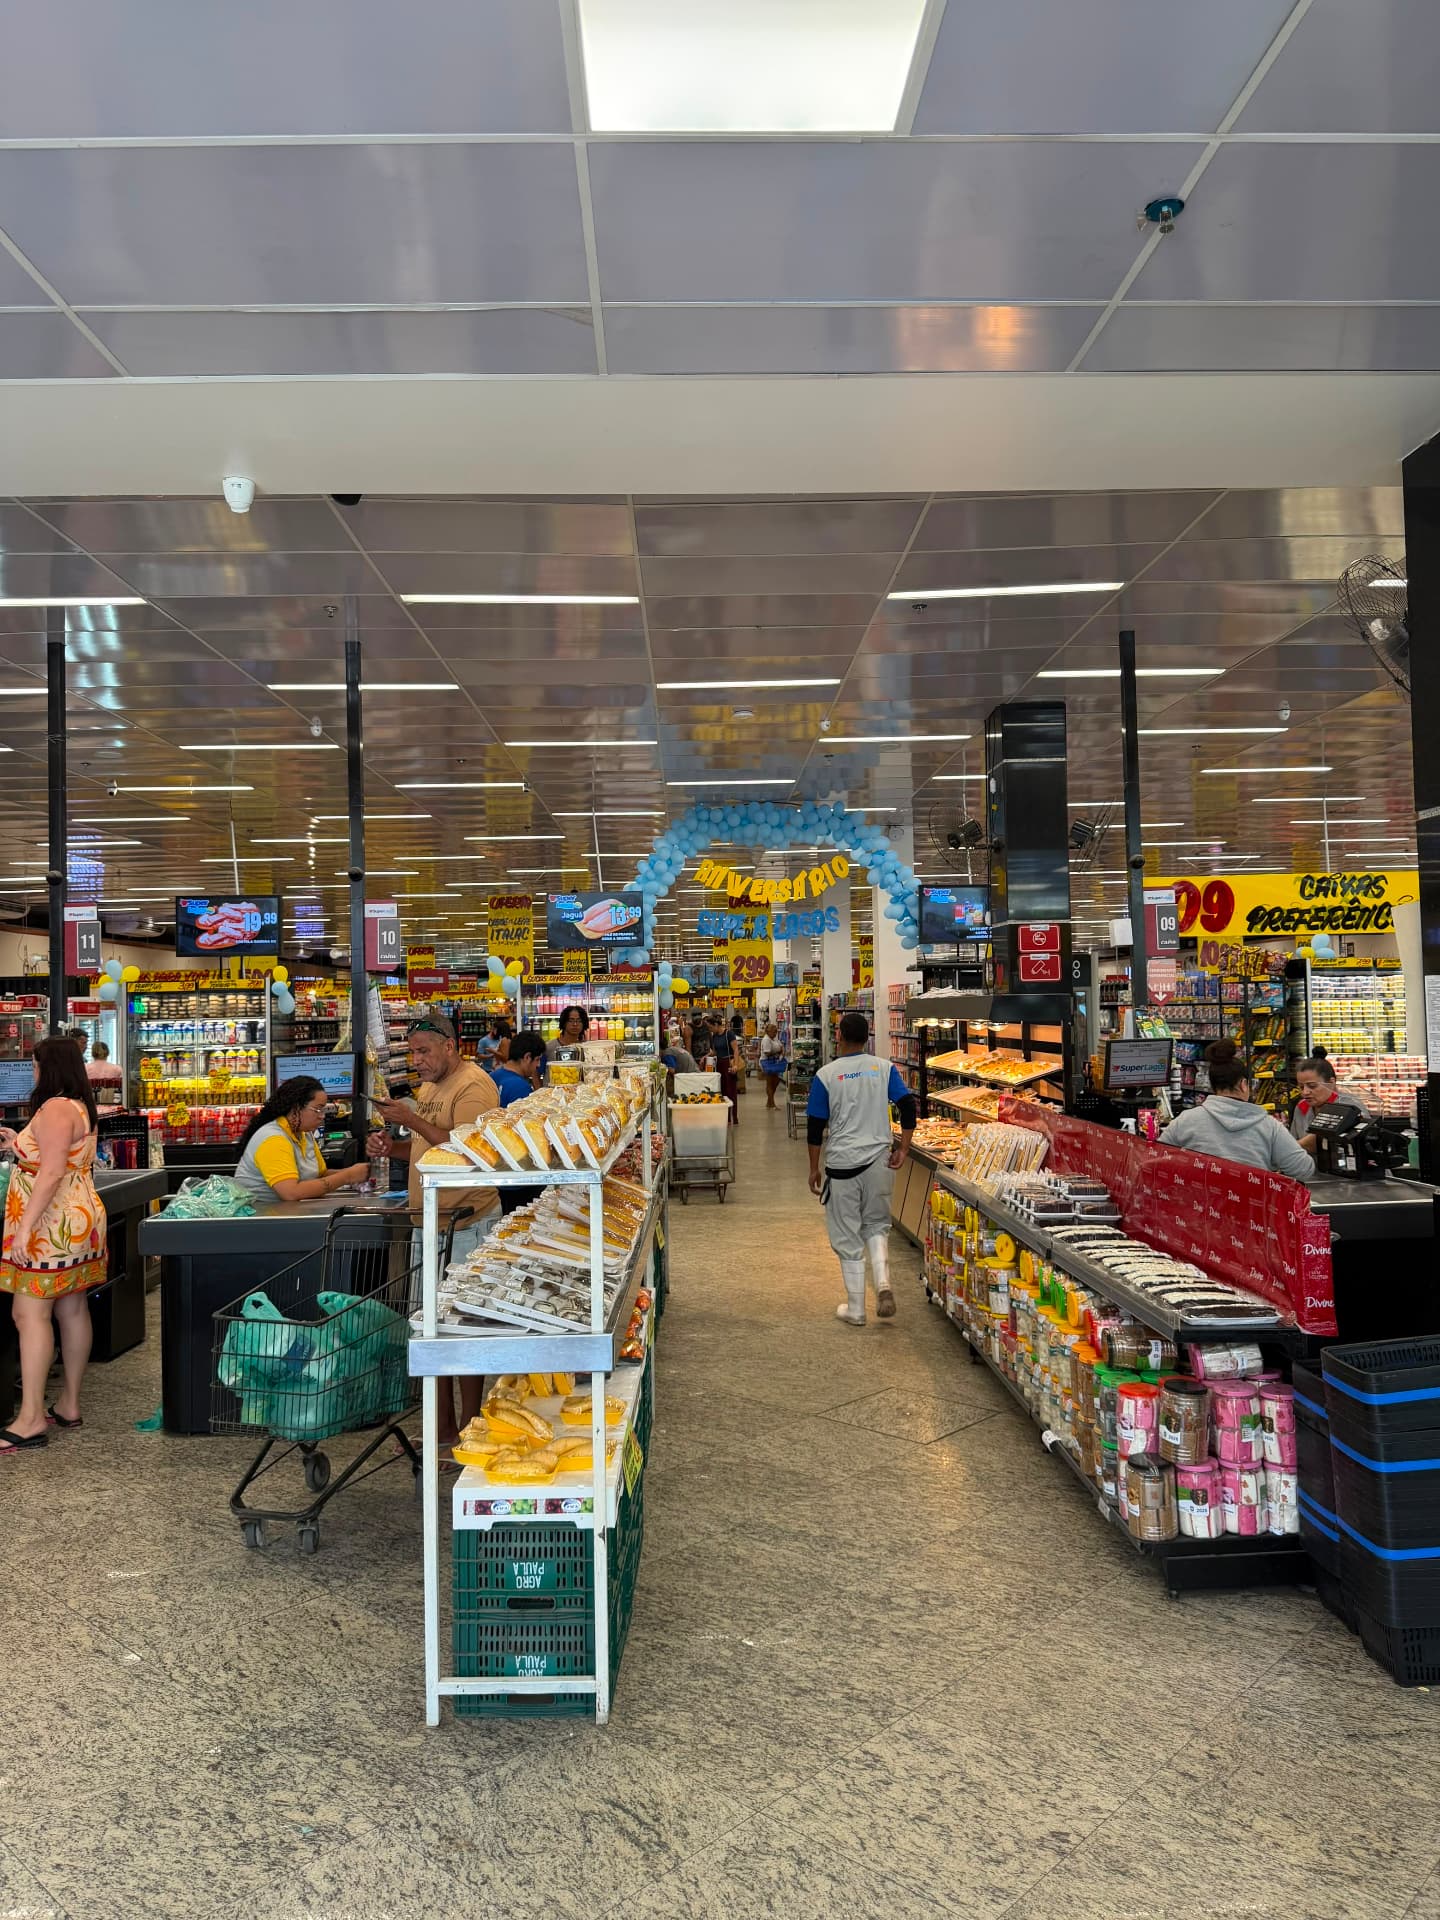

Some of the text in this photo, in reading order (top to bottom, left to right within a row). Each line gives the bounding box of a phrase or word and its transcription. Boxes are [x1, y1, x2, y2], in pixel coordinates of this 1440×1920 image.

[1300, 874, 1388, 900] CAIXAS
[1246, 897, 1396, 933] PREFERÊNC
[698, 910, 769, 940] SUPER
[773, 905, 841, 941] LAGOS
[1161, 917, 1176, 932] 09
[80, 934, 95, 949] 11
[382, 930, 396, 945] 10
[490, 927, 530, 942] ITALAC
[732, 955, 771, 982] 299
[1303, 1244, 1333, 1256] Divine
[1304, 1297, 1335, 1309] Divine
[513, 1562, 545, 1575] PAULA
[516, 1576, 542, 1589] AGRO
[515, 1656, 547, 1669] PAULA
